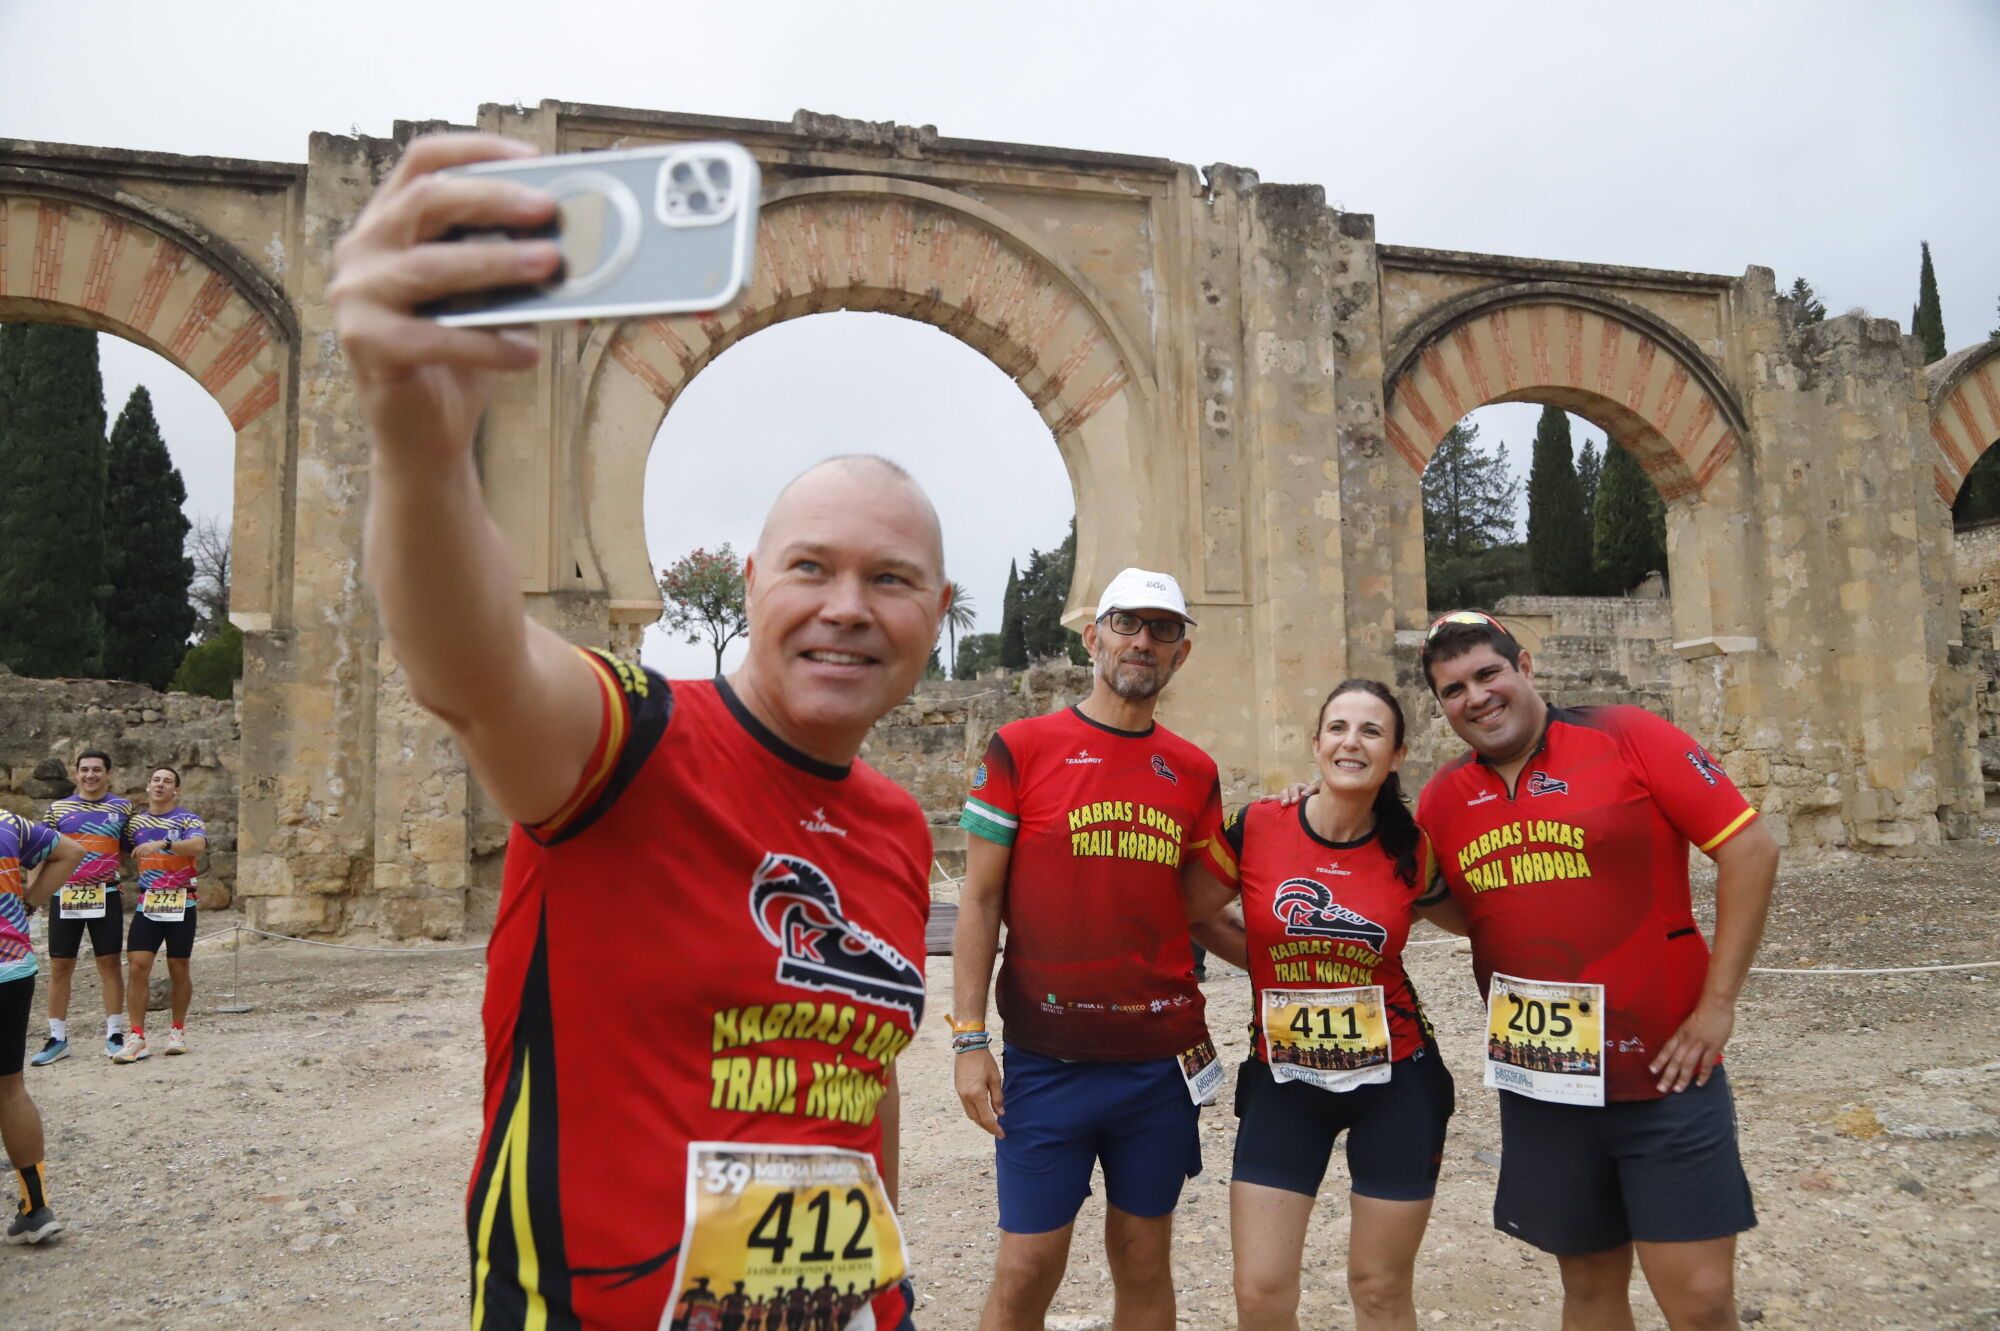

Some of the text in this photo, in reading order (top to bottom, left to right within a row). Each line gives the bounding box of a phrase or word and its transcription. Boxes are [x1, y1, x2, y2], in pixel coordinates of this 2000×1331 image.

[1068, 800, 1133, 831] KABRAS
[1139, 803, 1182, 845] LOKAS
[1071, 825, 1180, 869] TRAIL KÓRDOBA
[1458, 820, 1584, 871] KABRAS LOKAS
[1464, 846, 1592, 894] TRAIL KÓRDOBA
[71, 889, 96, 900] 275
[154, 893, 177, 904] 274
[1294, 911, 1314, 926] K
[791, 922, 828, 965] K
[1268, 940, 1384, 968] KABRAS LOKAS
[1274, 961, 1311, 982] TRAIL
[1270, 994, 1289, 1009] 39
[1508, 998, 1572, 1037] 205
[713, 1002, 911, 1065] KABRAS LOK
[1290, 1007, 1362, 1039] 411
[710, 1056, 797, 1114] TRAIL
[705, 1160, 751, 1195] 39
[747, 1188, 873, 1263] 412
